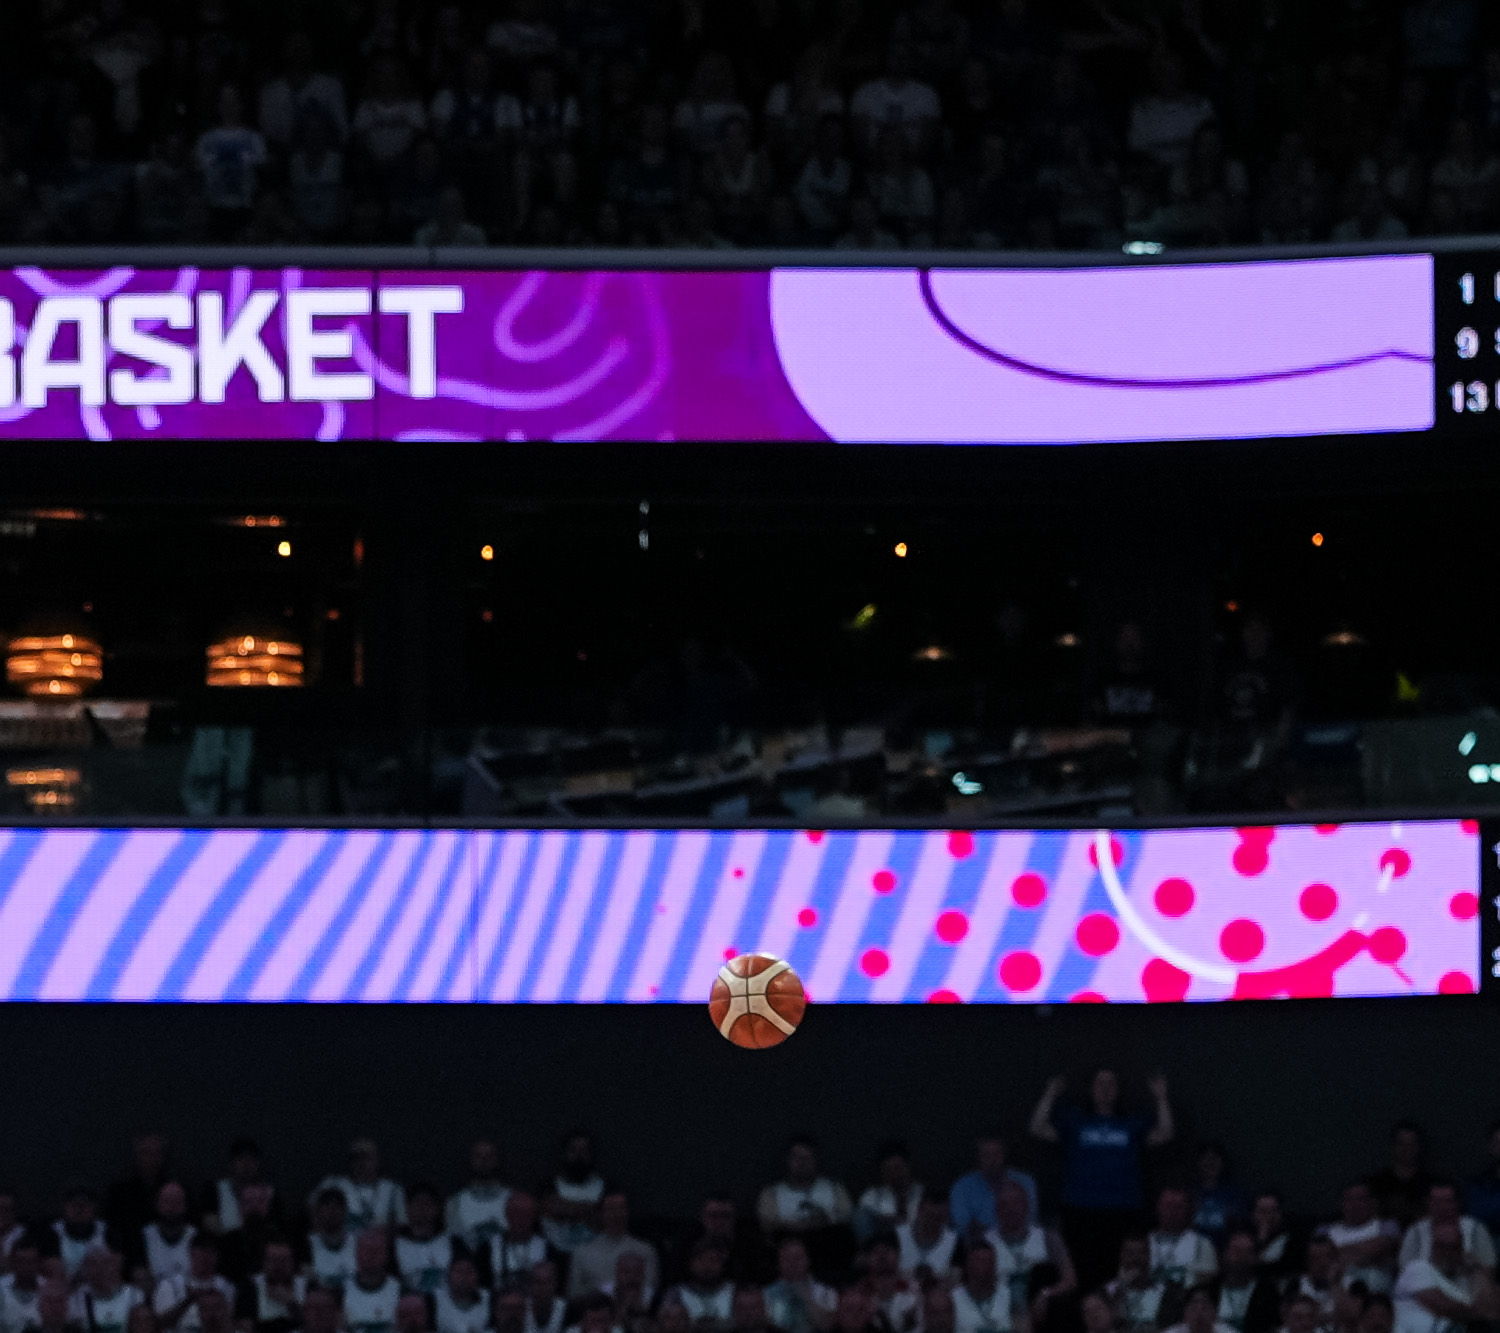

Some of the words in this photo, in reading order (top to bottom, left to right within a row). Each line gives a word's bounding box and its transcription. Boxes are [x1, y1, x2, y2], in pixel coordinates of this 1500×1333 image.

[1459, 272, 1475, 304] 1
[1455, 327, 1479, 359] 9
[1451, 380, 1489, 413] 13
